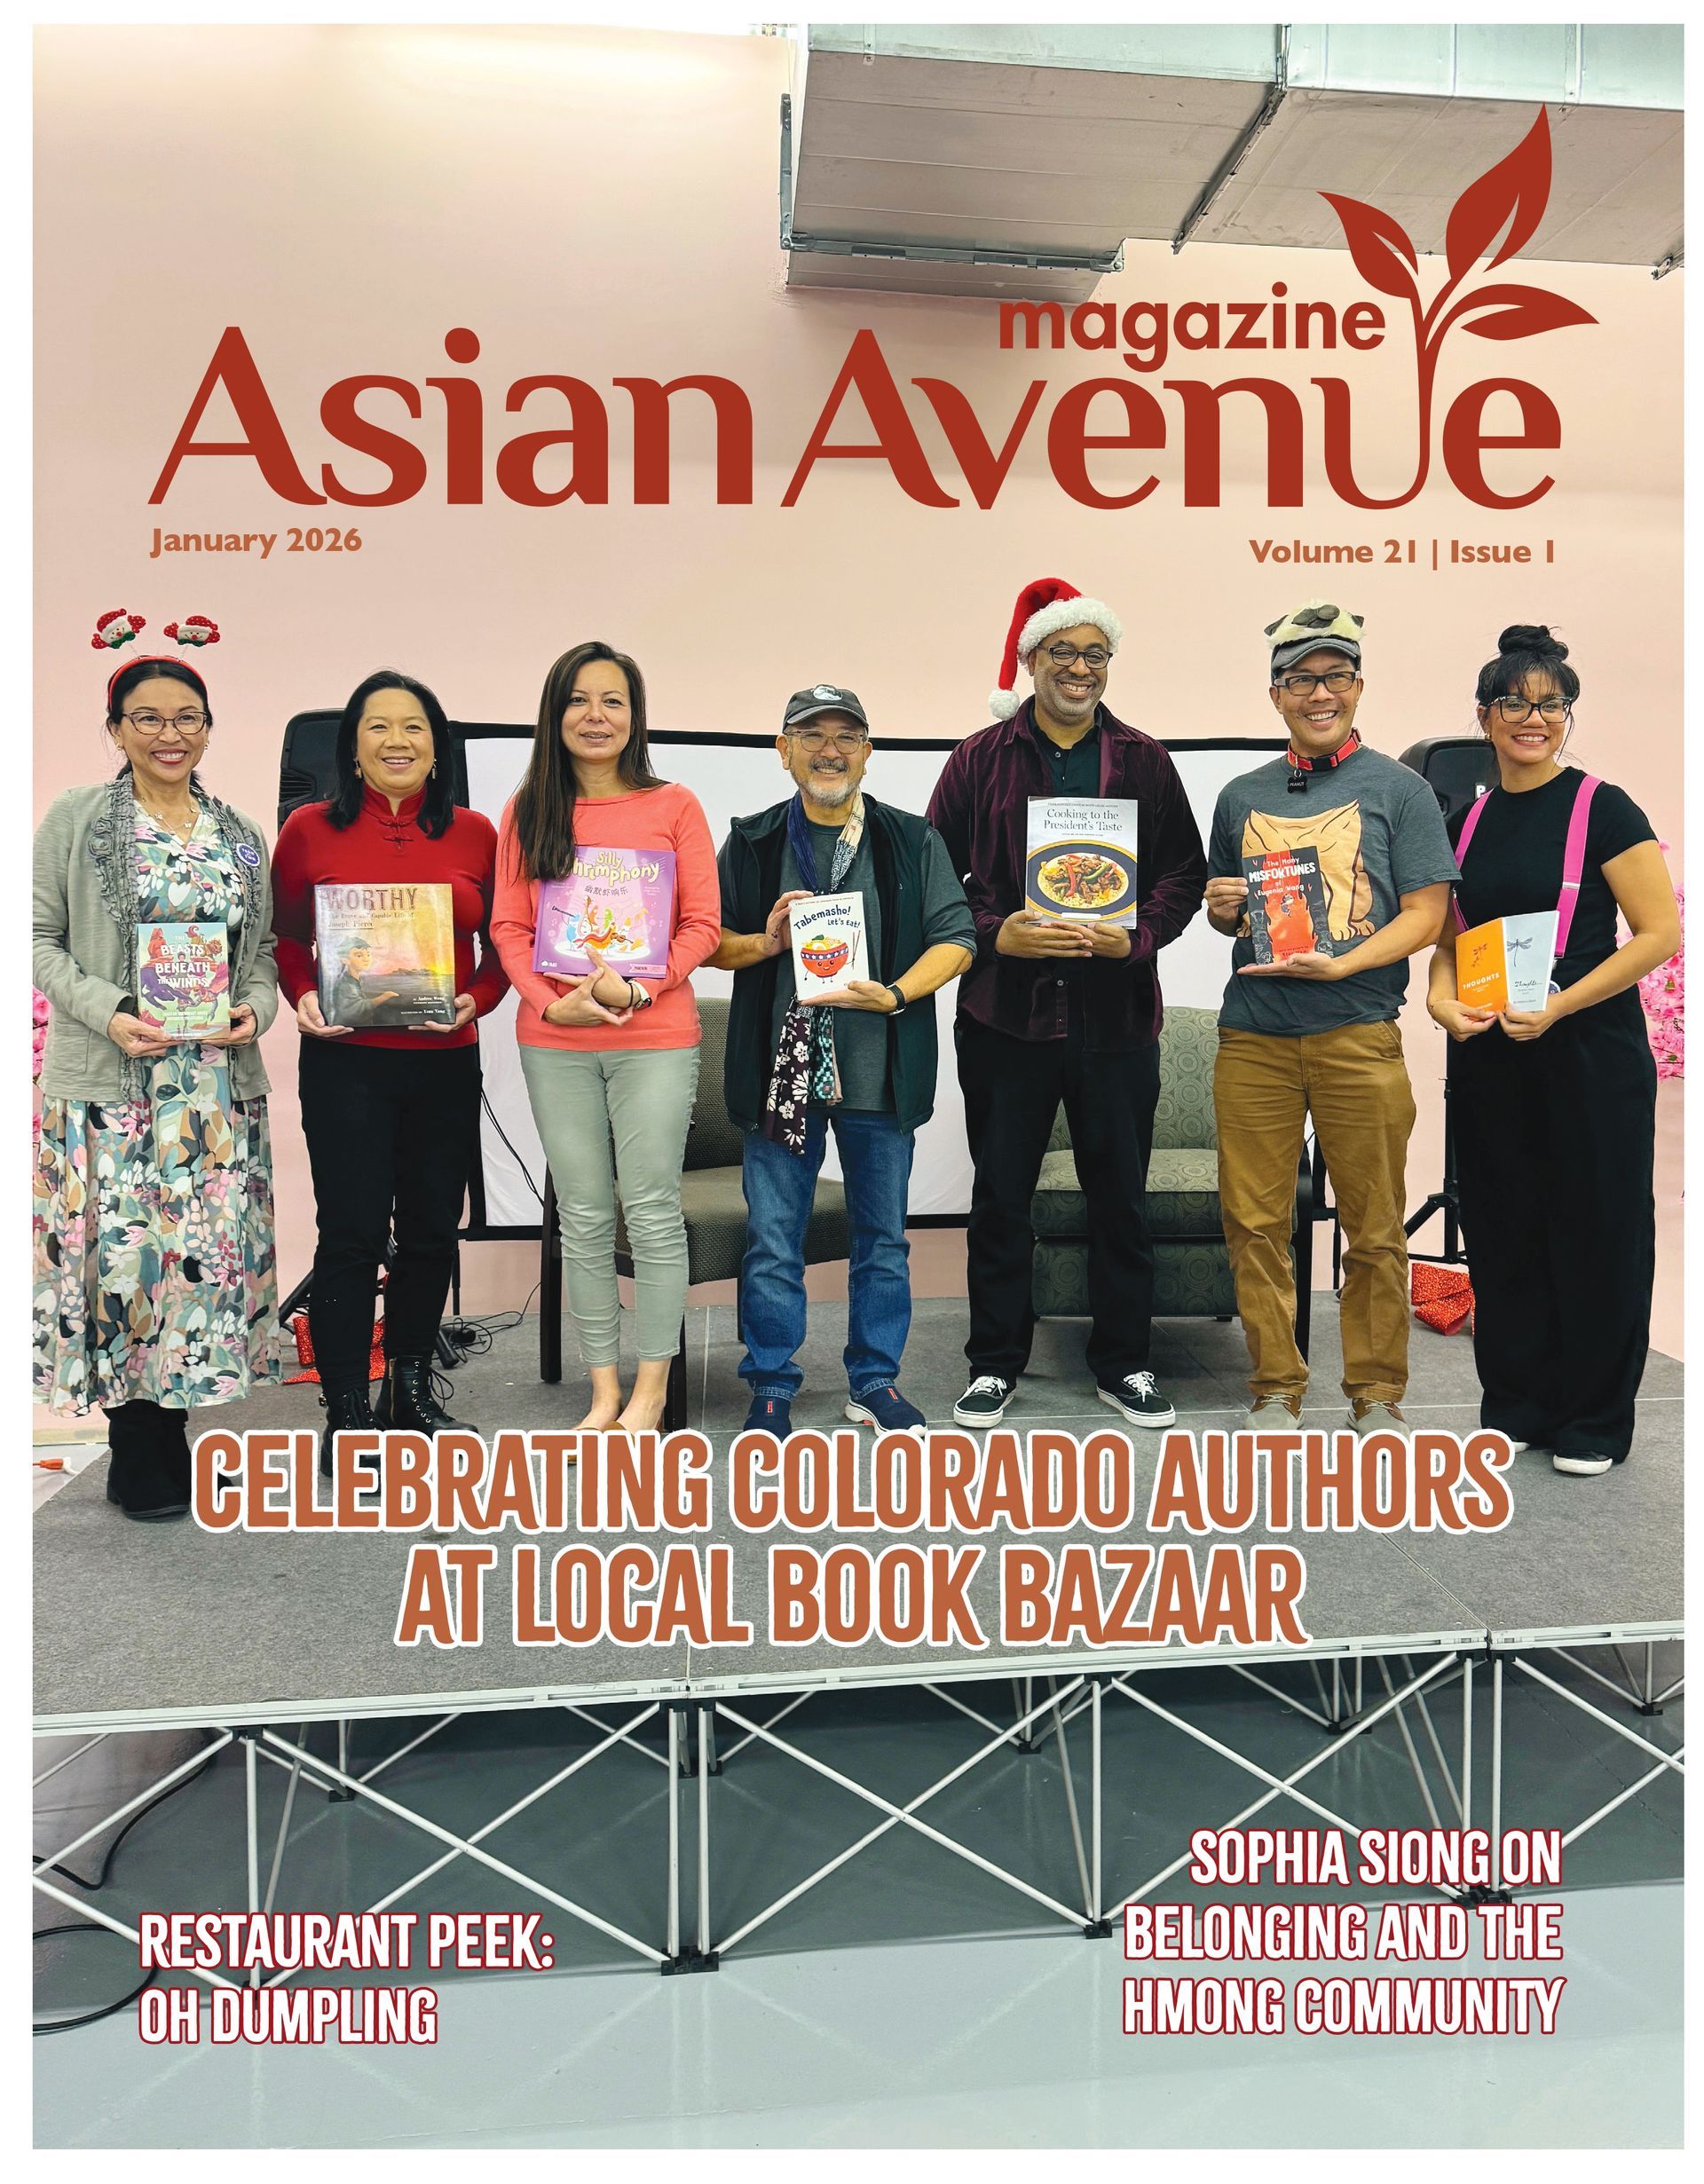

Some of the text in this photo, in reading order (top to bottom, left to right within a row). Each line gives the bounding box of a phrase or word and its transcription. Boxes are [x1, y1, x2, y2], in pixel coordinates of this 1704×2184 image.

[1047, 808, 1119, 821] Cooking to the
[1044, 820, 1123, 832] President's Taste
[596, 851, 623, 869] Silly
[573, 857, 659, 887] hrimphony
[1249, 862, 1316, 883] MISFORTUNES
[1258, 887, 1284, 896] Eugenia
[326, 887, 418, 911] WORTHY
[793, 904, 851, 930] Tabemasho!
[846, 919, 861, 928] Eat!
[160, 943, 204, 956] BEASTS
[154, 961, 210, 974] BENEATH
[169, 977, 210, 990] WINDS
[1463, 973, 1500, 990] THOUGHTS
